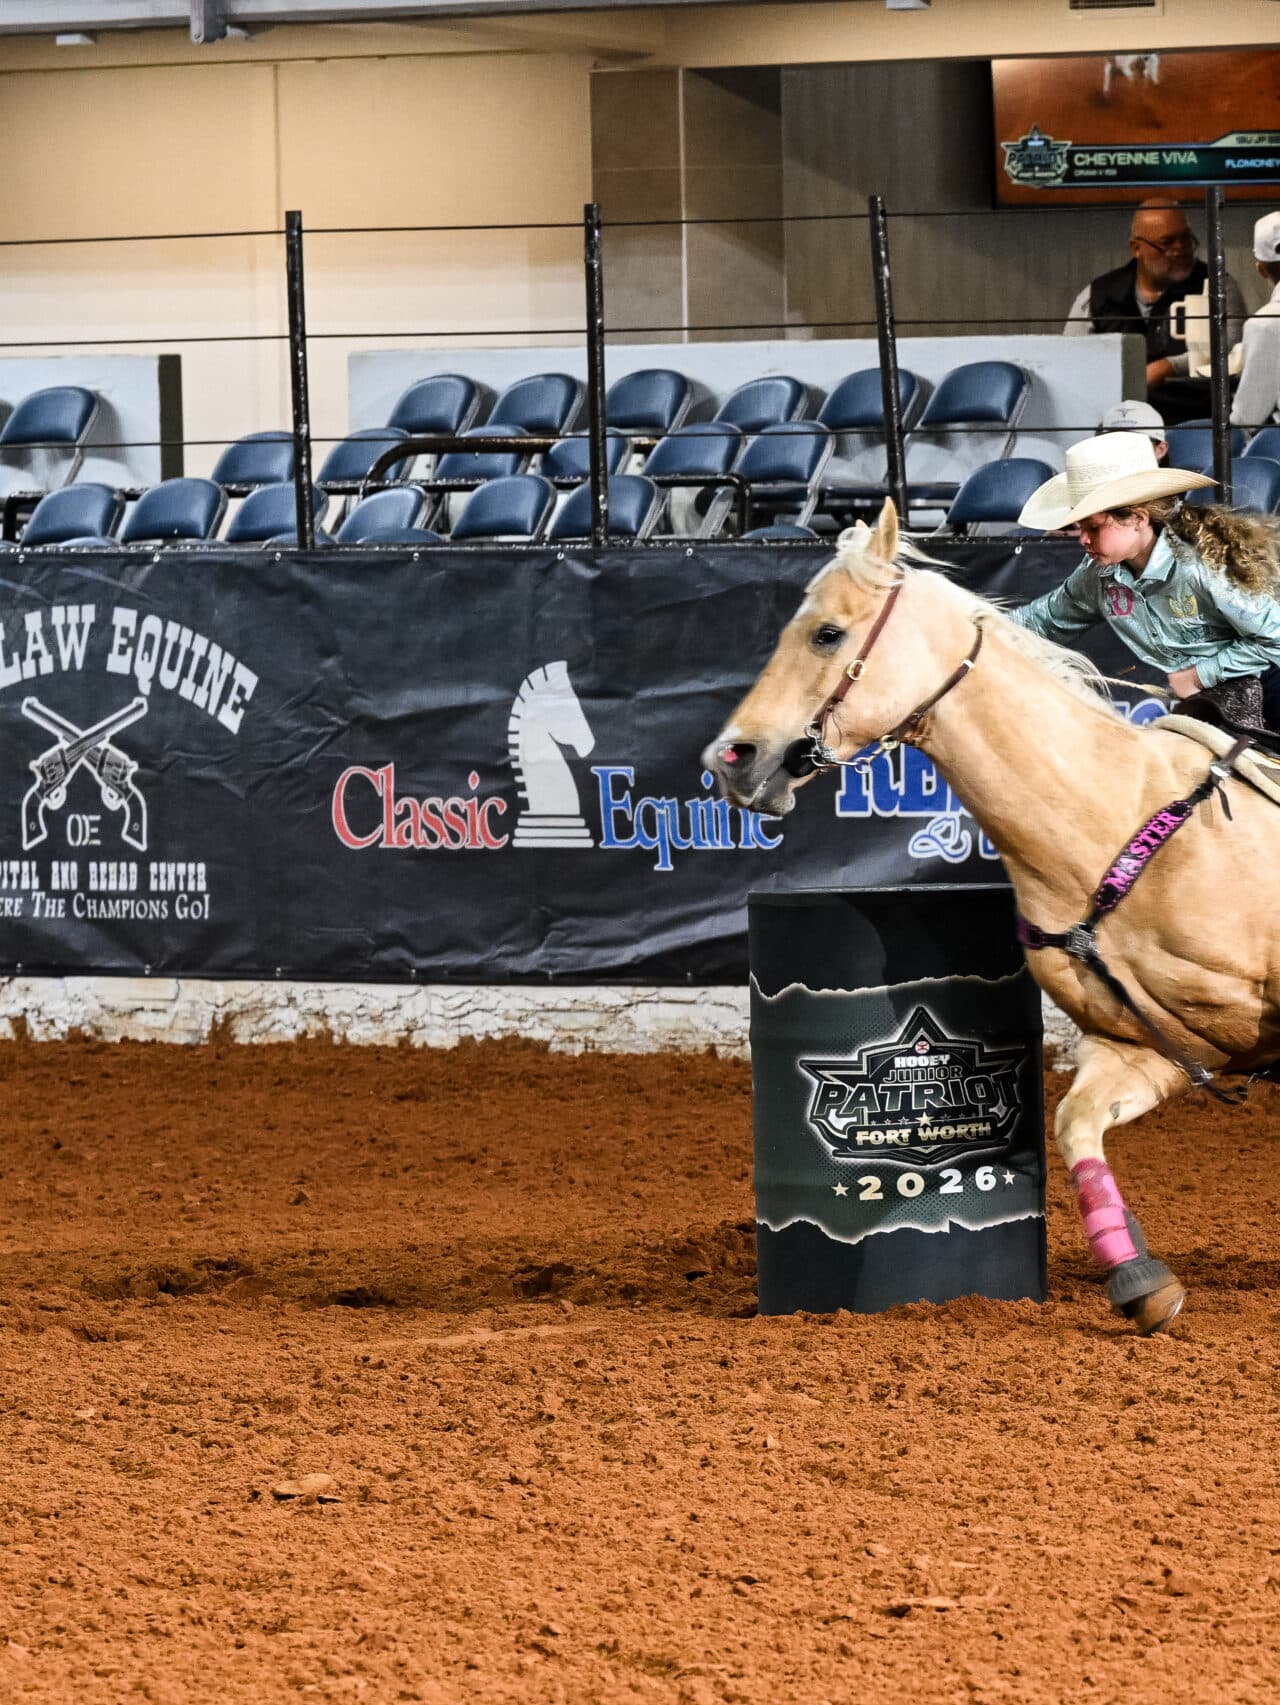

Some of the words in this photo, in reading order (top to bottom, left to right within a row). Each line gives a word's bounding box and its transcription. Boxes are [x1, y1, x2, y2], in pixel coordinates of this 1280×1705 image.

[1074, 152, 1159, 166] CHEYENNE
[1162, 151, 1198, 165] VIVA
[106, 606, 259, 736] EQUINE
[331, 762, 510, 850] Classic
[591, 765, 785, 871] Equine
[1104, 812, 1184, 892] MASTER
[149, 862, 207, 892] CENTER
[883, 1065, 963, 1084] JUNIOR
[894, 1054, 950, 1068] HOOEY
[813, 1070, 1020, 1116] PATRIOT
[856, 1127, 913, 1146] FORT
[918, 1121, 991, 1142] WORTH
[857, 1165, 997, 1201] 2026
